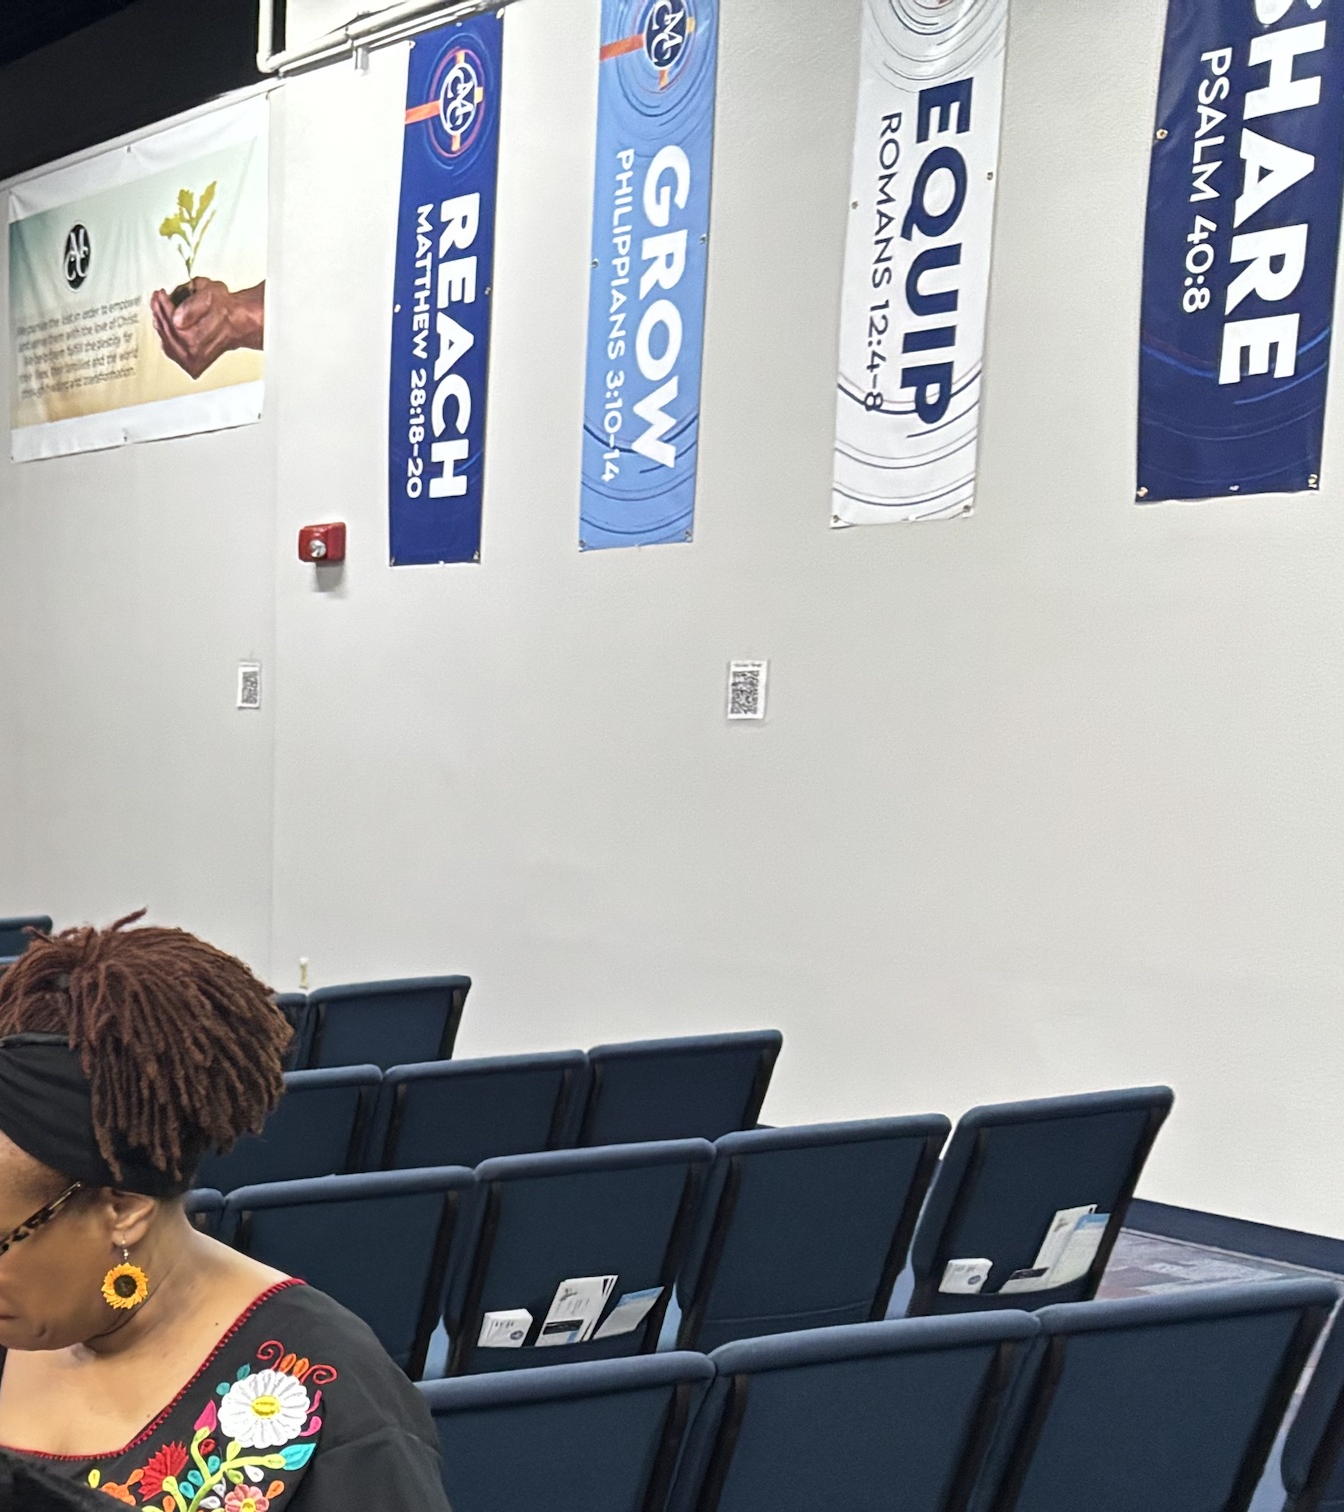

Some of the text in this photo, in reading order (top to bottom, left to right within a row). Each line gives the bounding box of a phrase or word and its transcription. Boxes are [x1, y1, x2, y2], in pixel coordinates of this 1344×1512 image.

[601, 148, 635, 483] PHILIPPIANS 3:10-14
[631, 145, 691, 469] GROW
[864, 112, 902, 414] ROMANS 12:4-8
[899, 77, 975, 425] EQUIP
[1181, 46, 1233, 313] PSALM 40:8
[406, 205, 433, 499] MATTHEW 28:18-20
[428, 192, 481, 499] REACH
